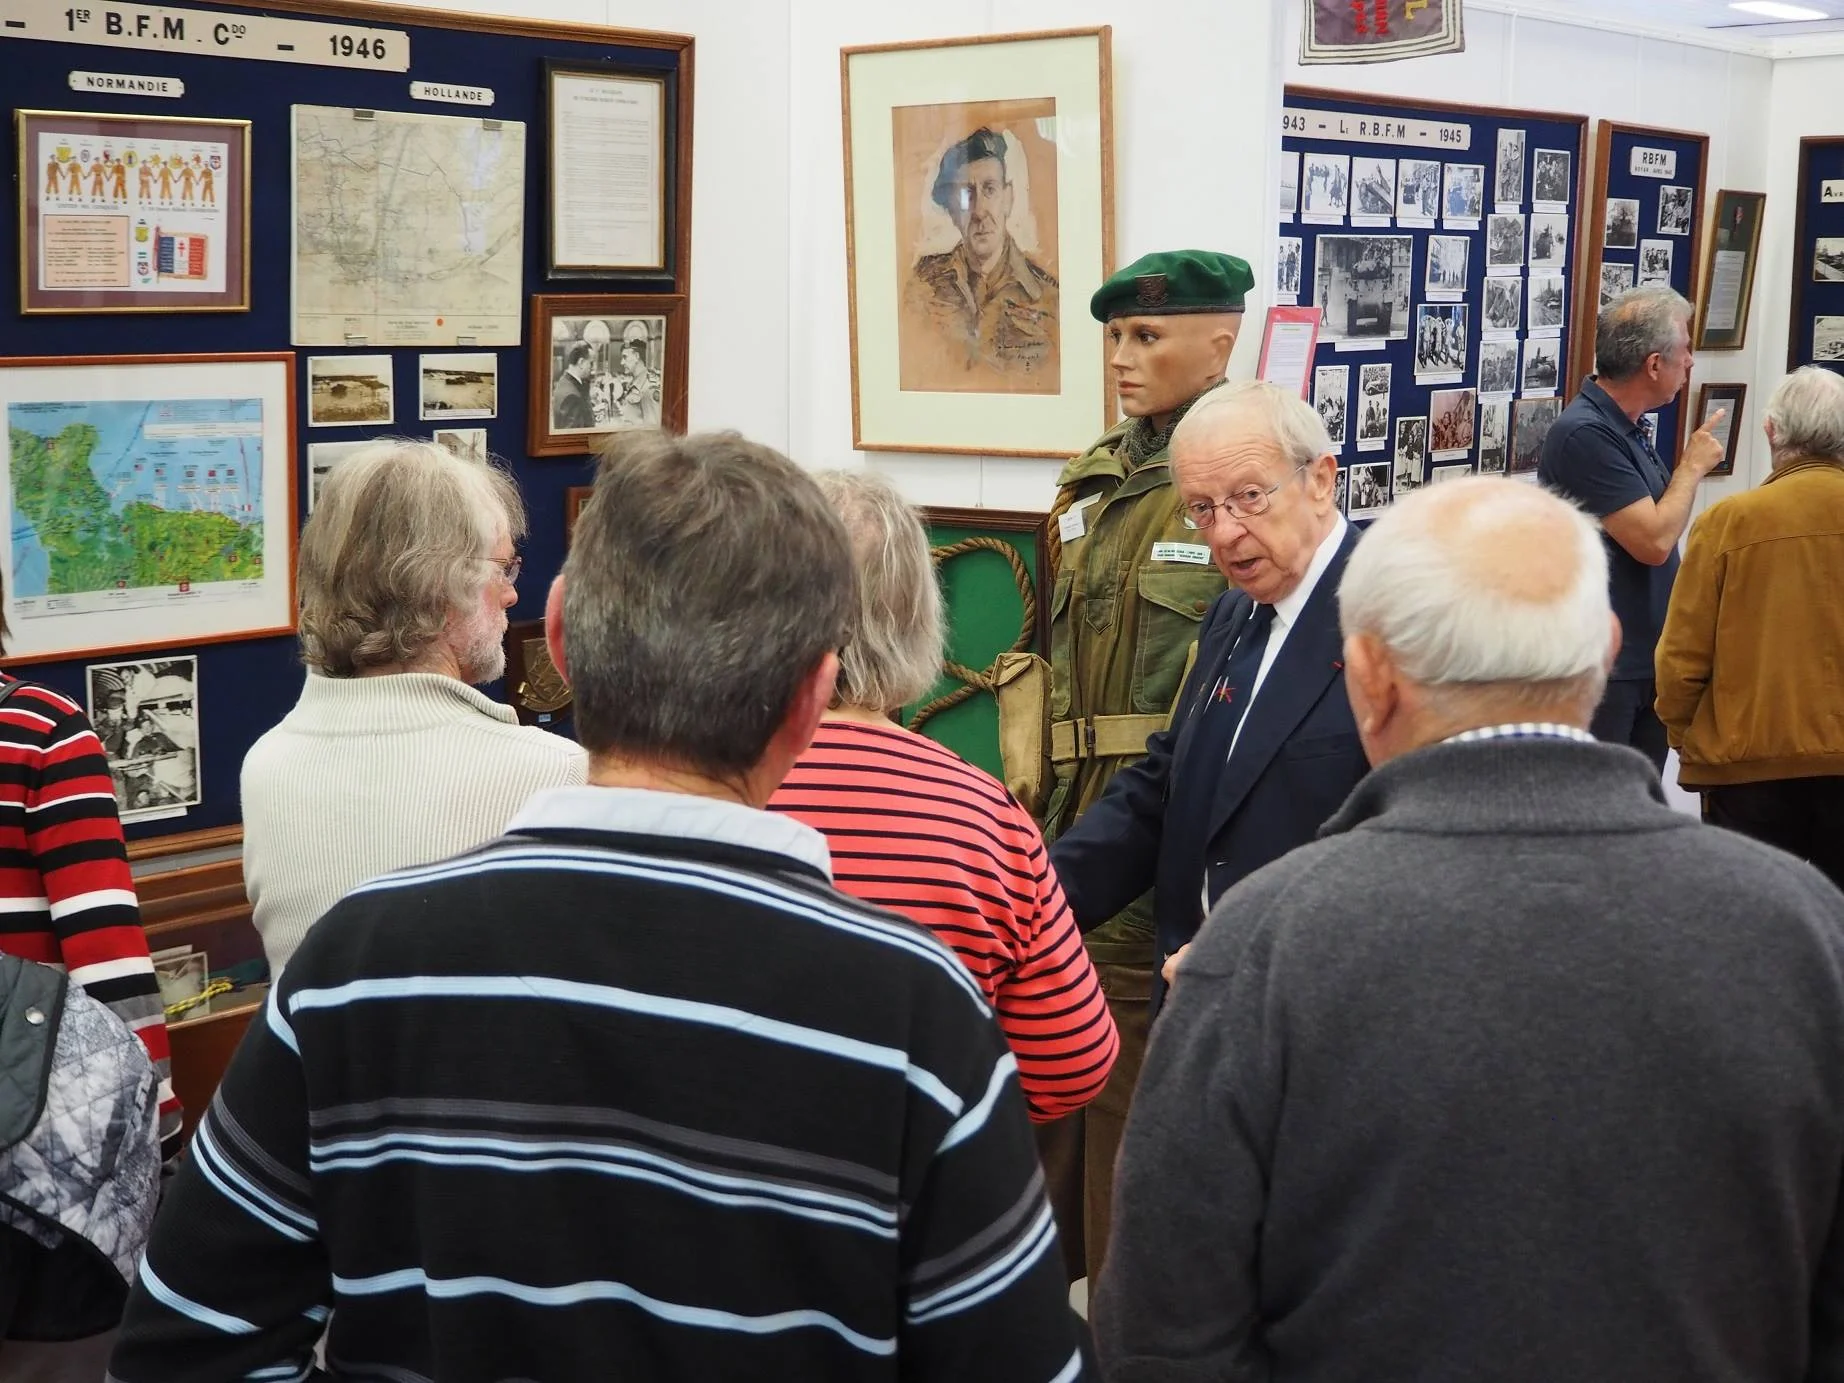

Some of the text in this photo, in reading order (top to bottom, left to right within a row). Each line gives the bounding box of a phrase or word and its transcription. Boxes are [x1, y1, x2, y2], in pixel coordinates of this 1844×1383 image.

[329, 34, 387, 60] 1946
[86, 76, 169, 92] NORMANDIE
[423, 86, 483, 101] HOLLANDE
[1359, 121, 1406, 139] R.B.F.M
[1439, 128, 1462, 144] 1945
[1642, 151, 1667, 166] RBFM
